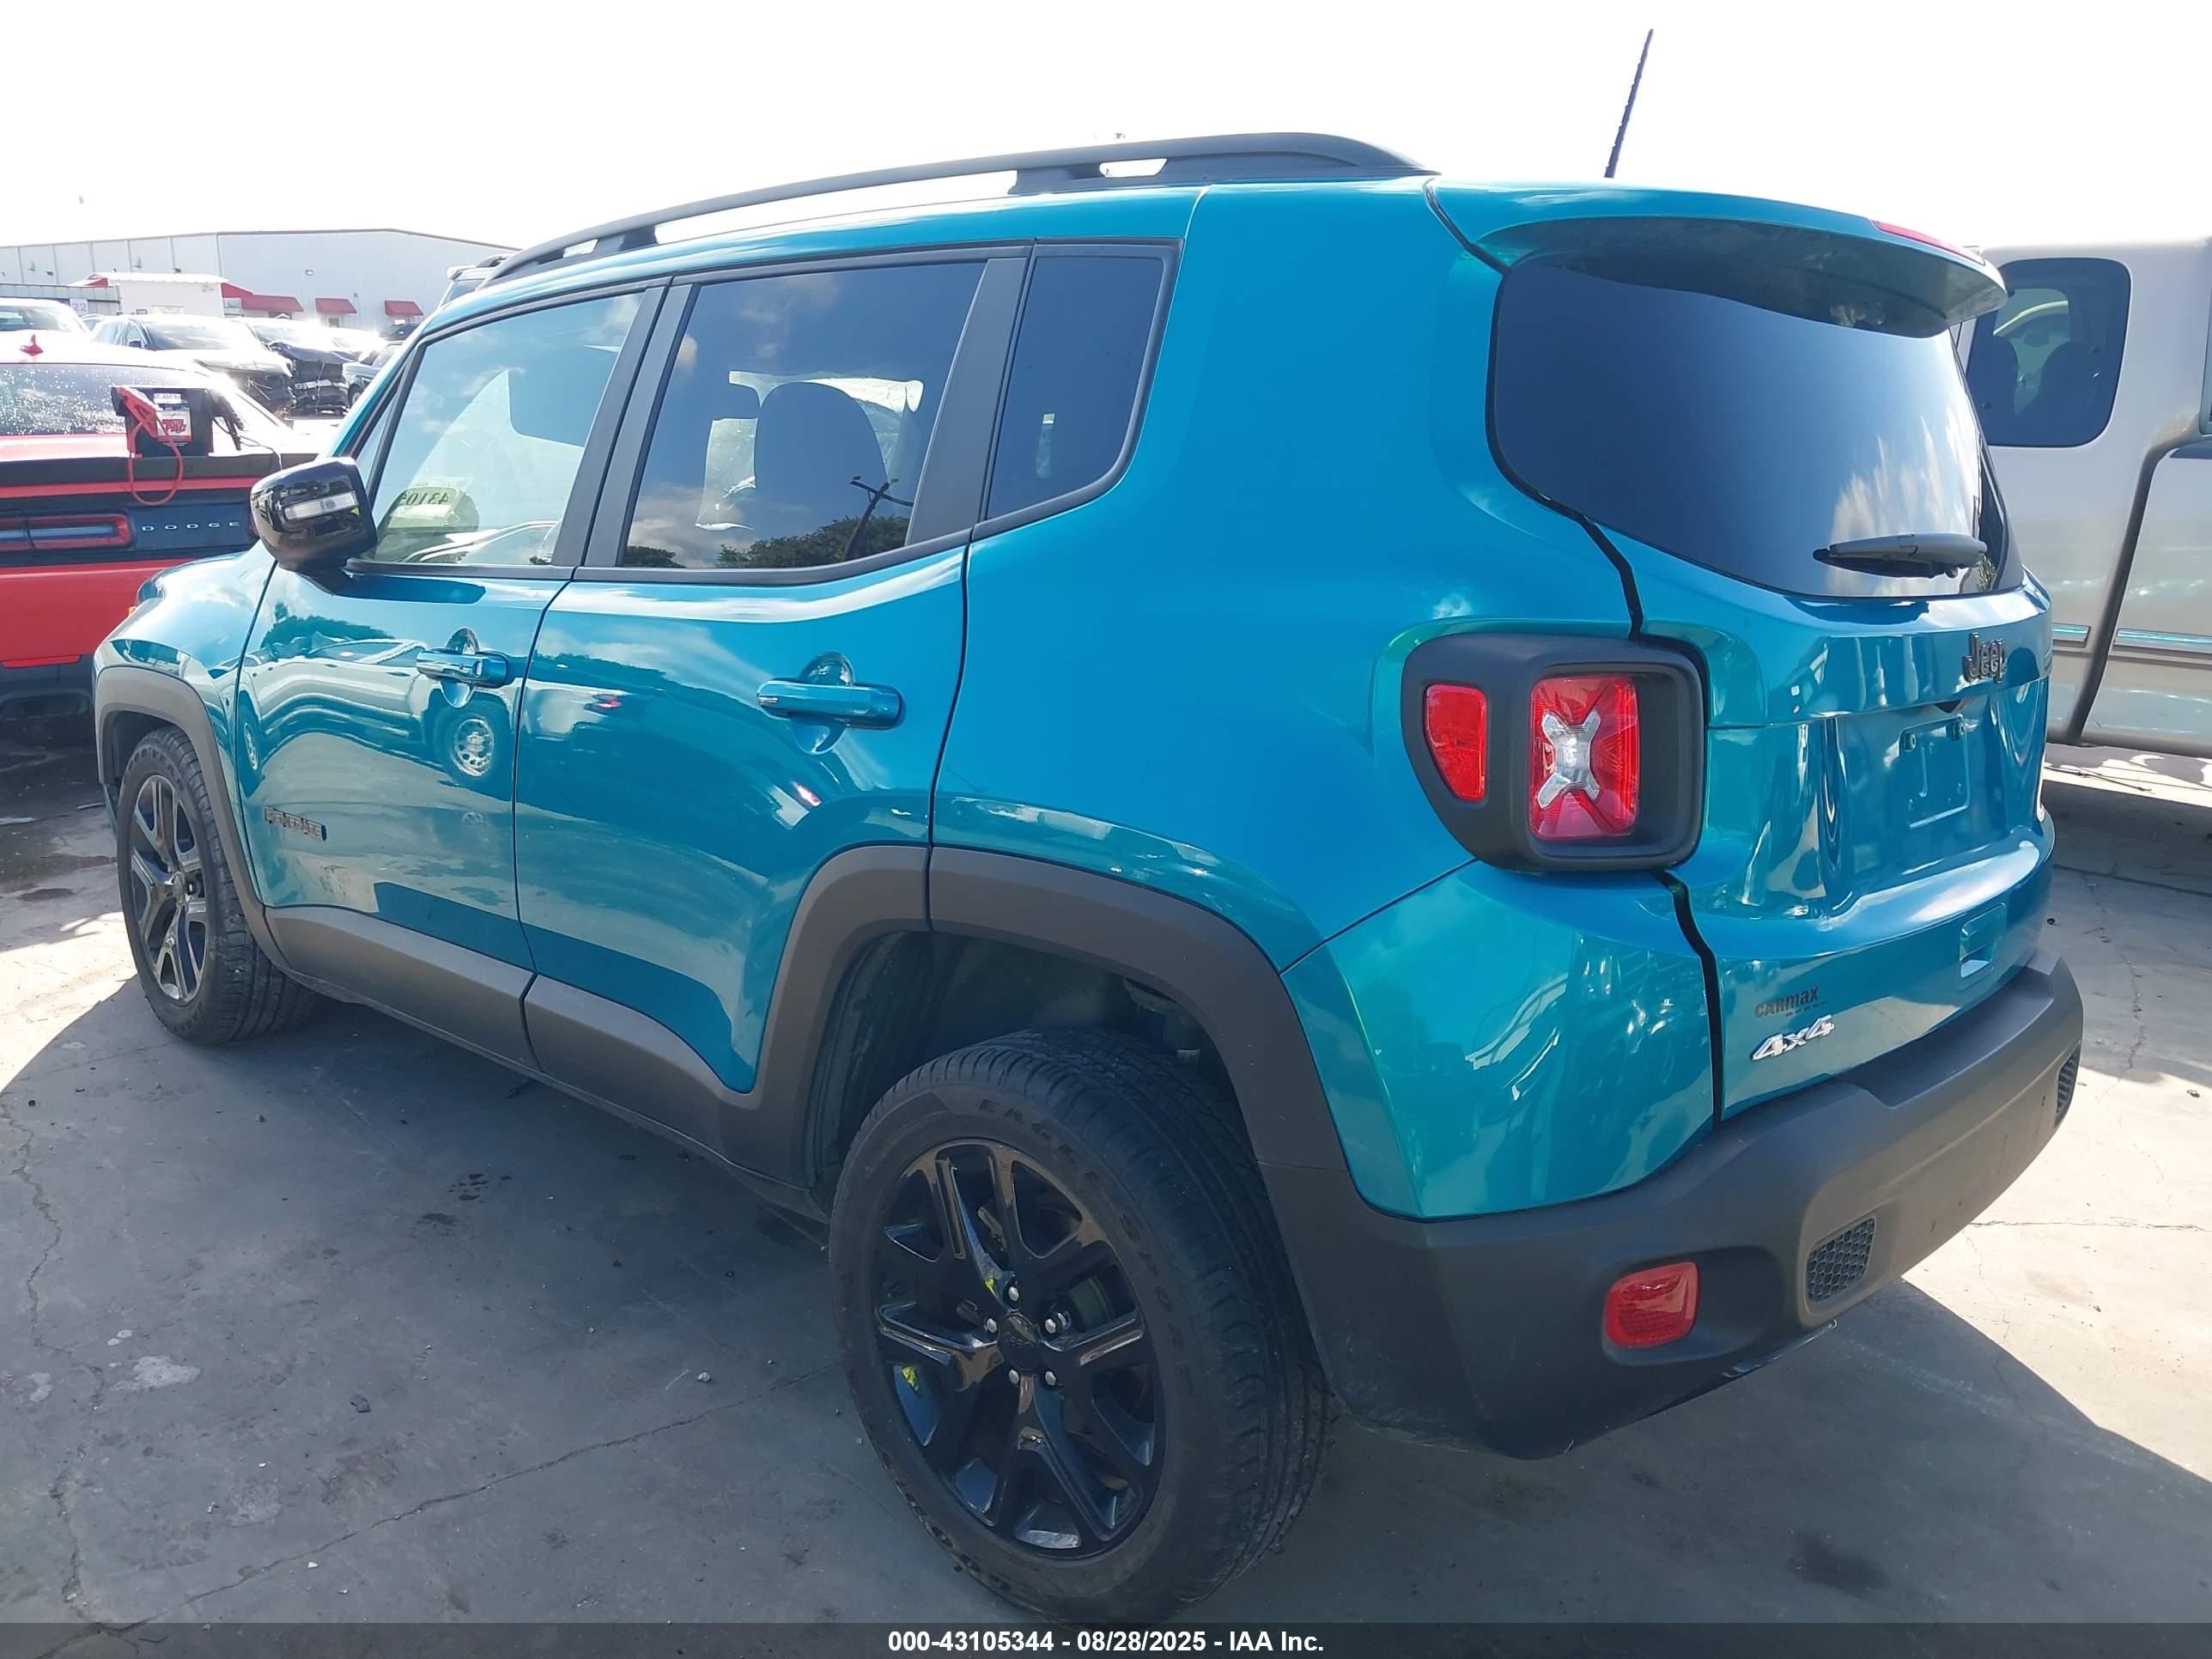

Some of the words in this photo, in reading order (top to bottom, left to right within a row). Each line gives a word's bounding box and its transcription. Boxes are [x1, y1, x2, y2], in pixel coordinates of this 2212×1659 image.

[142, 521, 240, 532] DODGE
[1962, 632, 2007, 684] Jeep
[1752, 1014, 1835, 1060] 4x4
